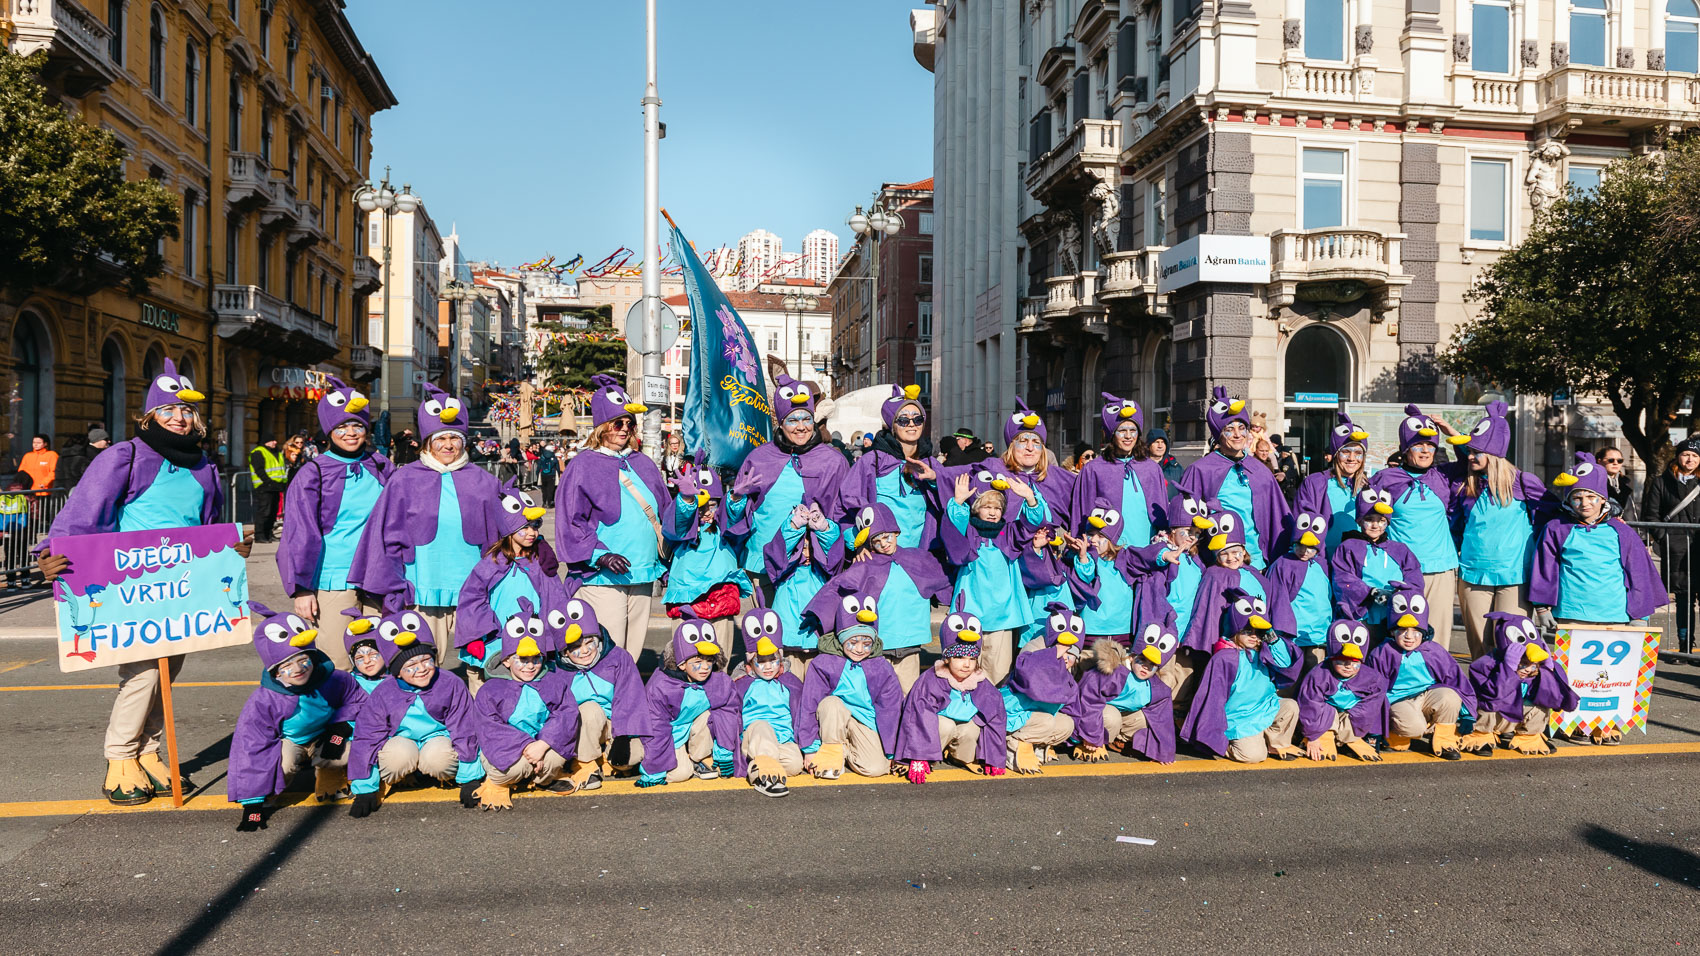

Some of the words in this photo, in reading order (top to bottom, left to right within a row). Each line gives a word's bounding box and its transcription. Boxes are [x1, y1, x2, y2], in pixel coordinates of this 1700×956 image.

[1204, 254, 1237, 266] Agram
[1238, 257, 1266, 266] Banka
[142, 303, 180, 333] DOUGLAS
[268, 385, 328, 400] CASIN
[729, 429, 747, 440] NOVI
[116, 537, 191, 569] DJEČJI
[119, 571, 191, 604] VRTIĆ
[90, 609, 232, 651] FIJOLICA
[1580, 640, 1631, 666] 29
[330, 734, 343, 746] 95
[248, 812, 262, 822] 95
